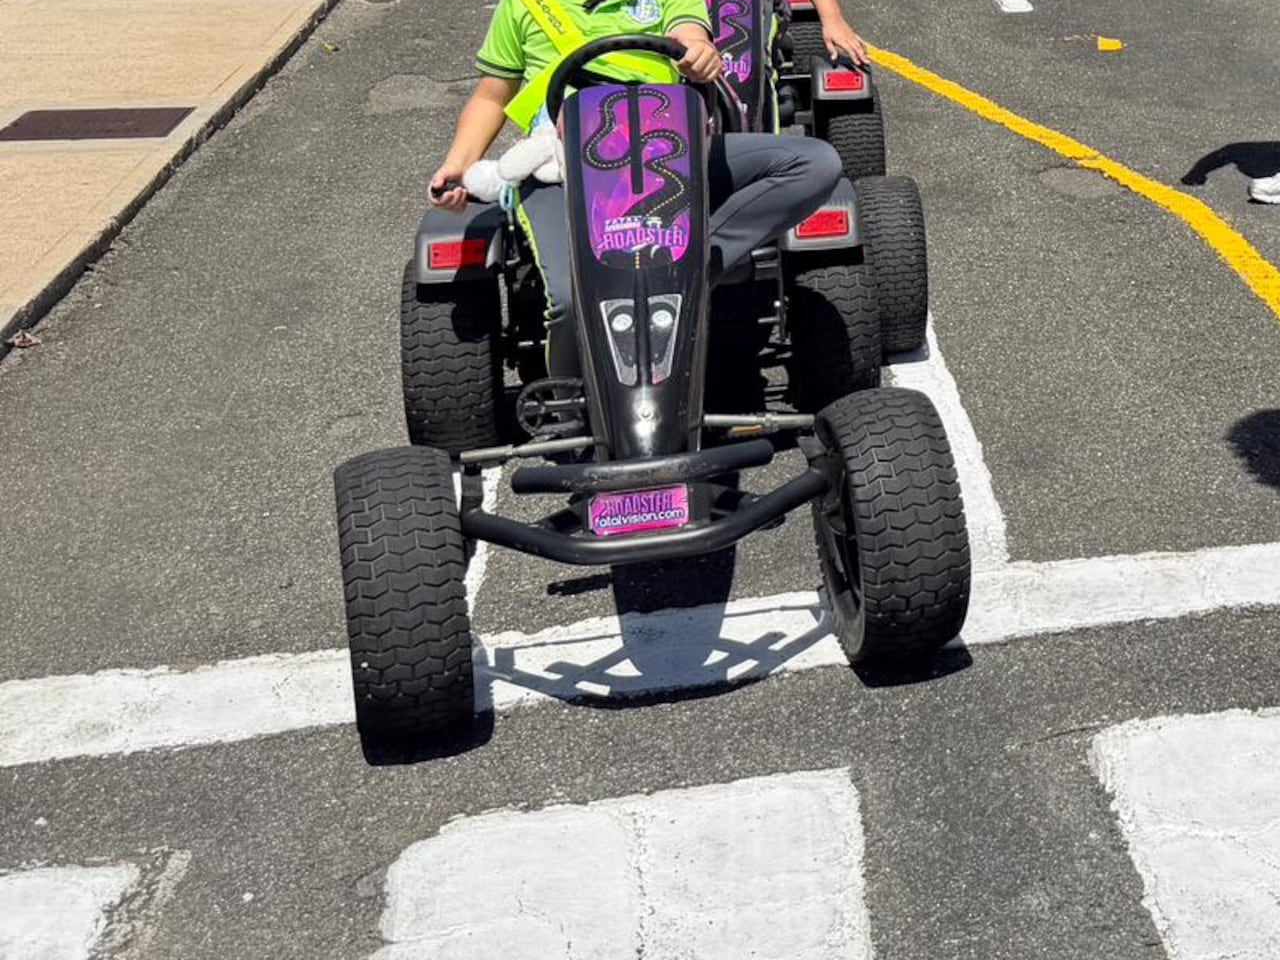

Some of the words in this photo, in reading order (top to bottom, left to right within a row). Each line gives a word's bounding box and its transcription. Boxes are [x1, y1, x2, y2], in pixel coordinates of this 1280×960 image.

[597, 227, 684, 250] ROADSTER
[602, 492, 673, 516] ROADSTER
[594, 507, 684, 528] fatalvision.com
